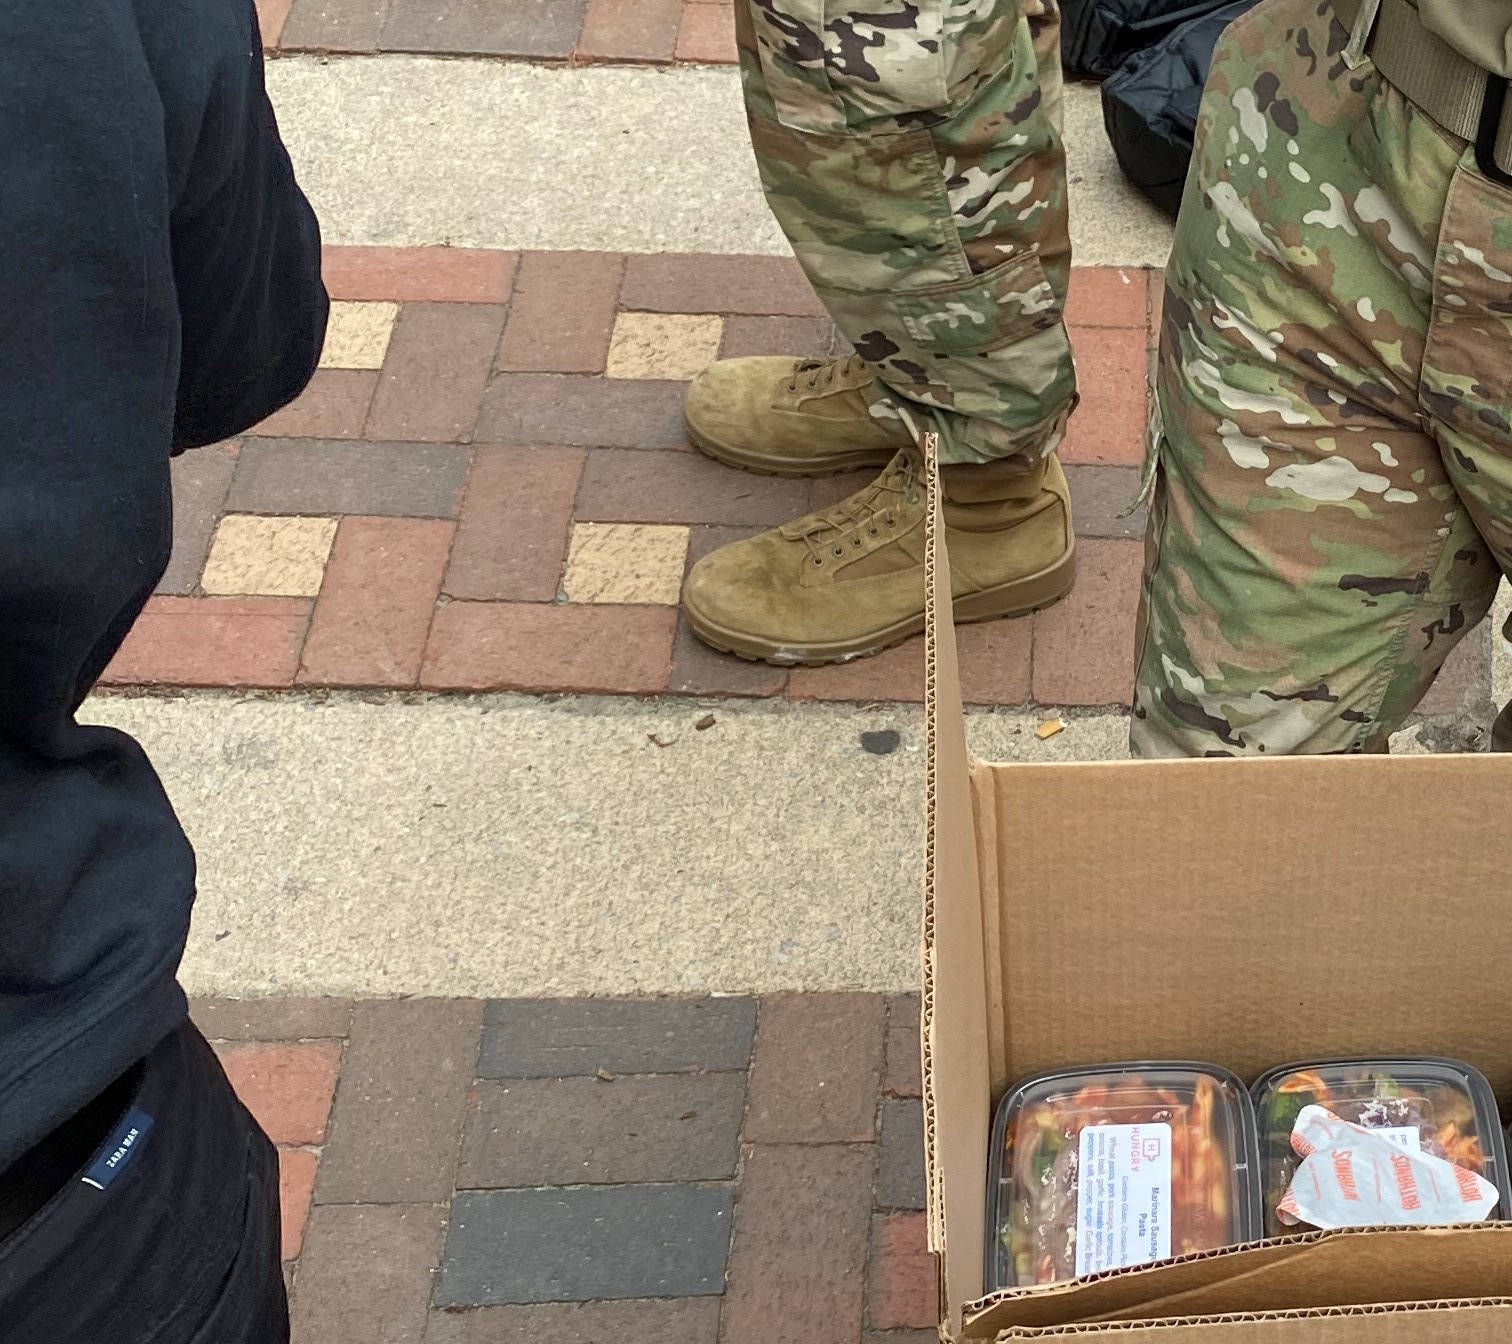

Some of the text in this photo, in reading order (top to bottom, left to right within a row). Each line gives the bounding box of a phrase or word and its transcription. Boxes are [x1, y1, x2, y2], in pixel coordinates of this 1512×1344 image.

[106, 1128, 139, 1168] ZARA MAN
[1130, 1126, 1140, 1173] HUNGRY
[1150, 1186, 1160, 1224] Marinara
[1138, 1213, 1147, 1237] Pasta
